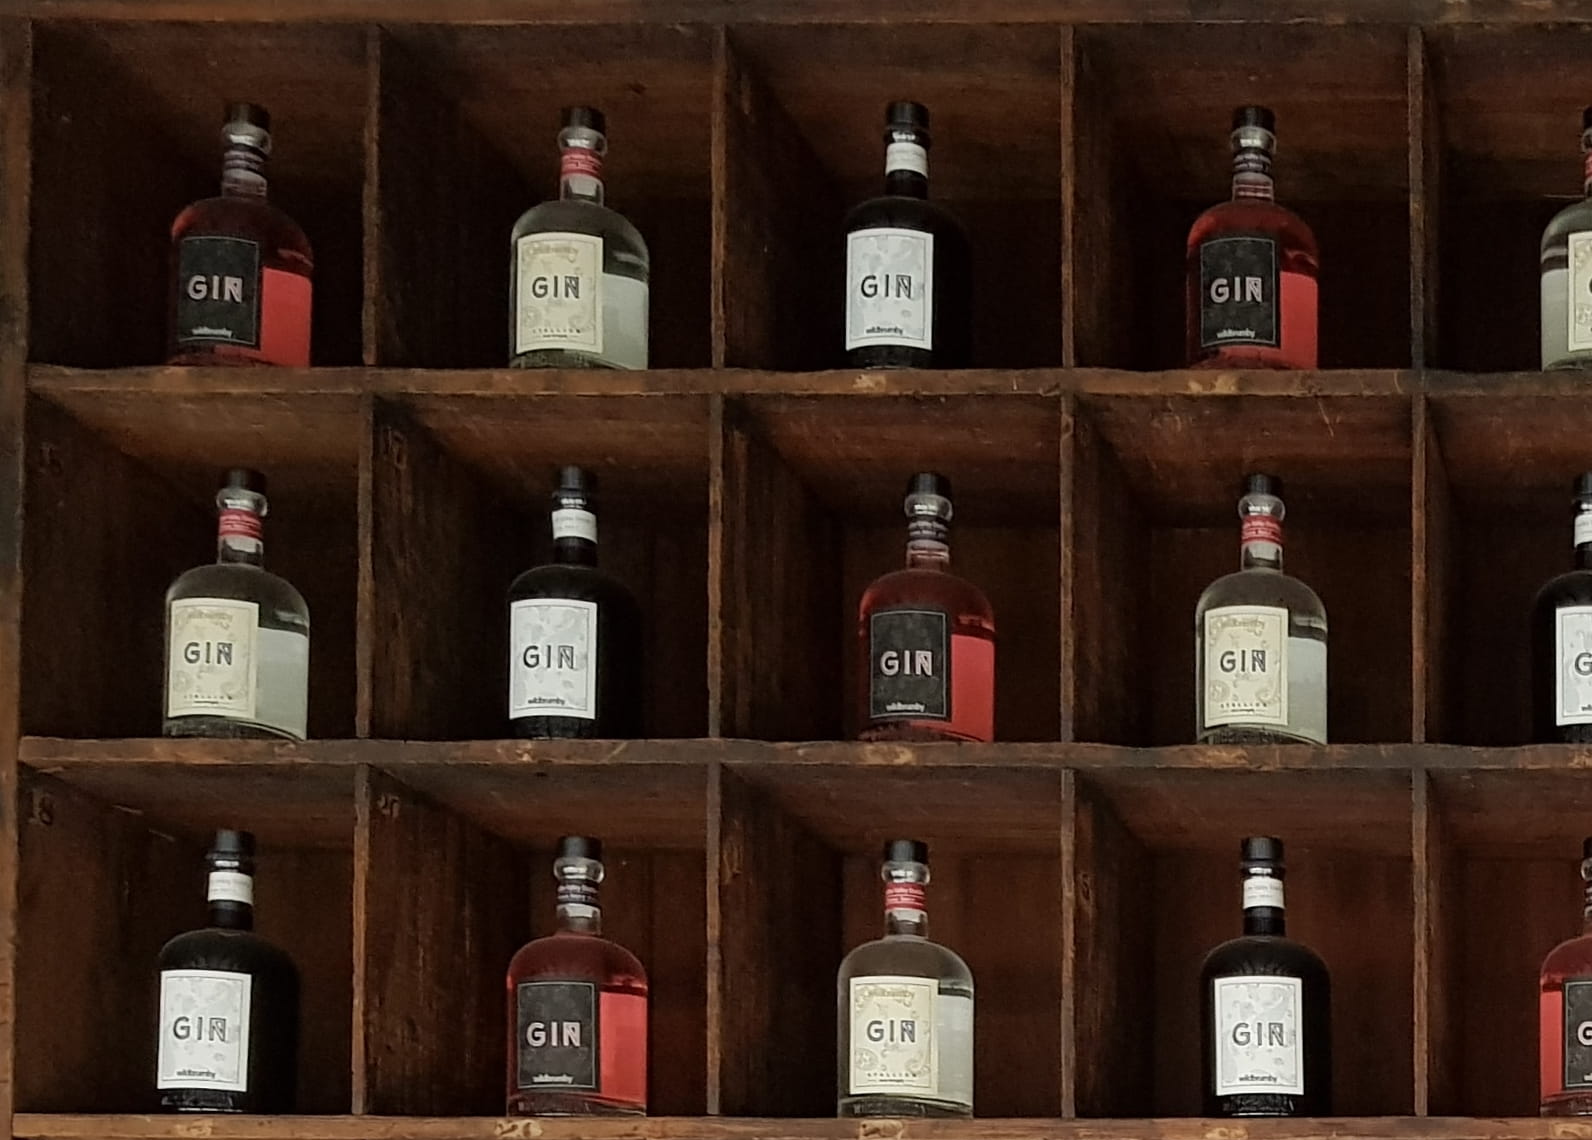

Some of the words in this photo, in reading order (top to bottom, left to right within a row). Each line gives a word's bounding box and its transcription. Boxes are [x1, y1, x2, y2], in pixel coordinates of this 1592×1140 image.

[188, 275, 243, 303] GIN
[532, 276, 579, 299] GIN
[861, 275, 911, 299] GIN
[1210, 277, 1262, 303] GIN
[184, 642, 232, 665] GIN
[524, 645, 574, 669] GIN
[880, 651, 932, 676] GIN
[1220, 650, 1266, 673] GIN
[173, 1017, 226, 1041] GIN
[527, 1022, 580, 1047] GIN
[867, 1020, 915, 1043] GIN
[1233, 1023, 1284, 1046] GIN
